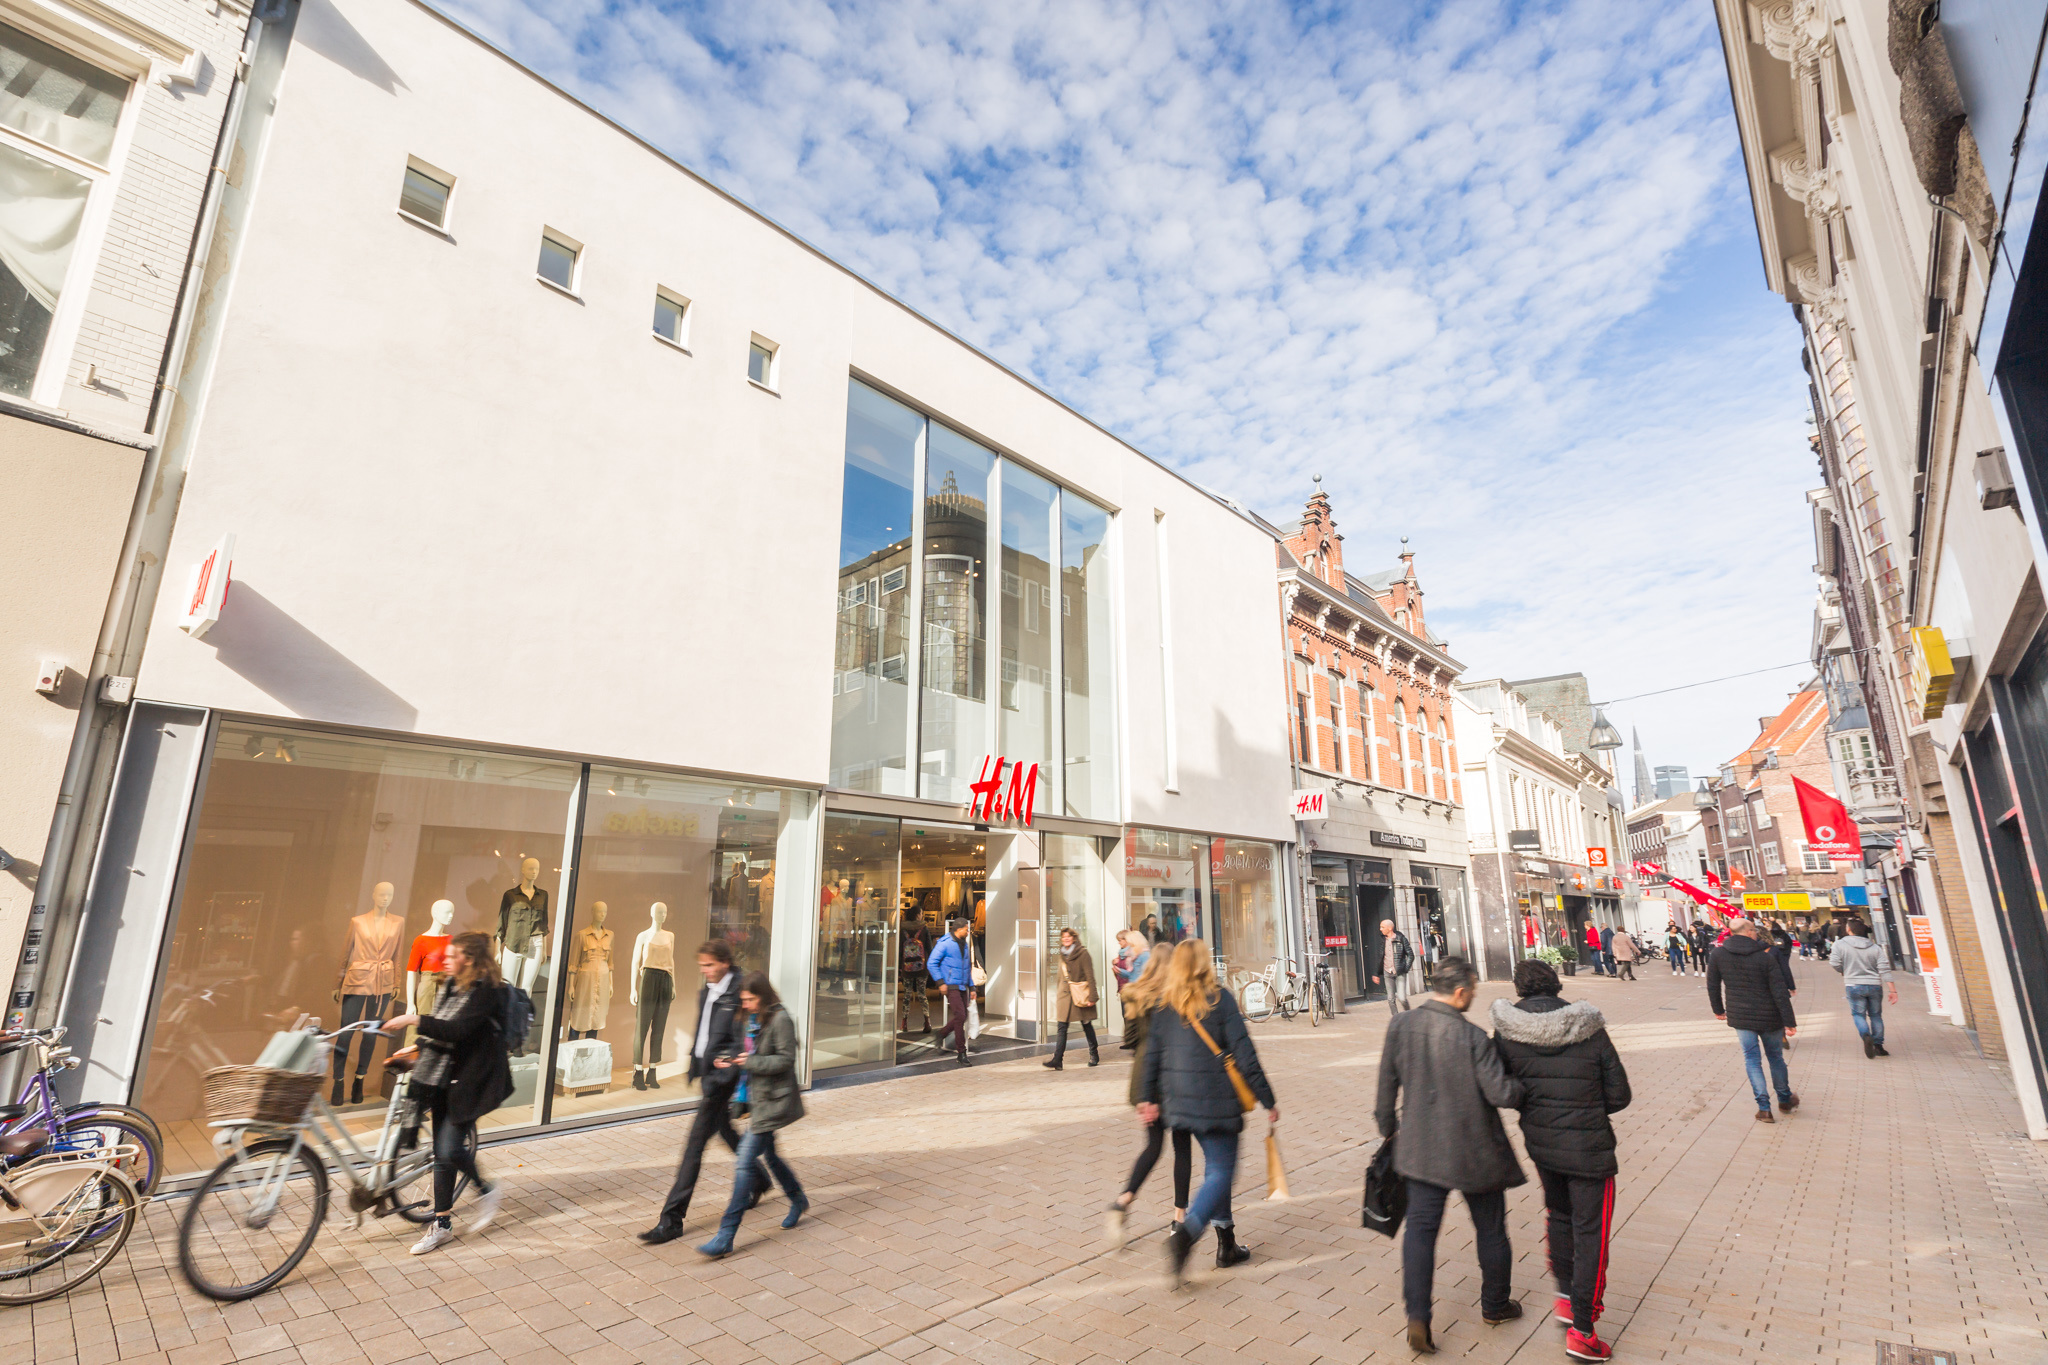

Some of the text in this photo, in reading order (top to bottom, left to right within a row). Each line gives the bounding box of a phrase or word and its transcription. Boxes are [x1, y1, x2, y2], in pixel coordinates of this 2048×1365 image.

[969, 754, 1039, 827] H&M
[1296, 793, 1324, 815] H&M
[1808, 841, 1850, 849] vodafone
[1746, 897, 1774, 906] FEBO
